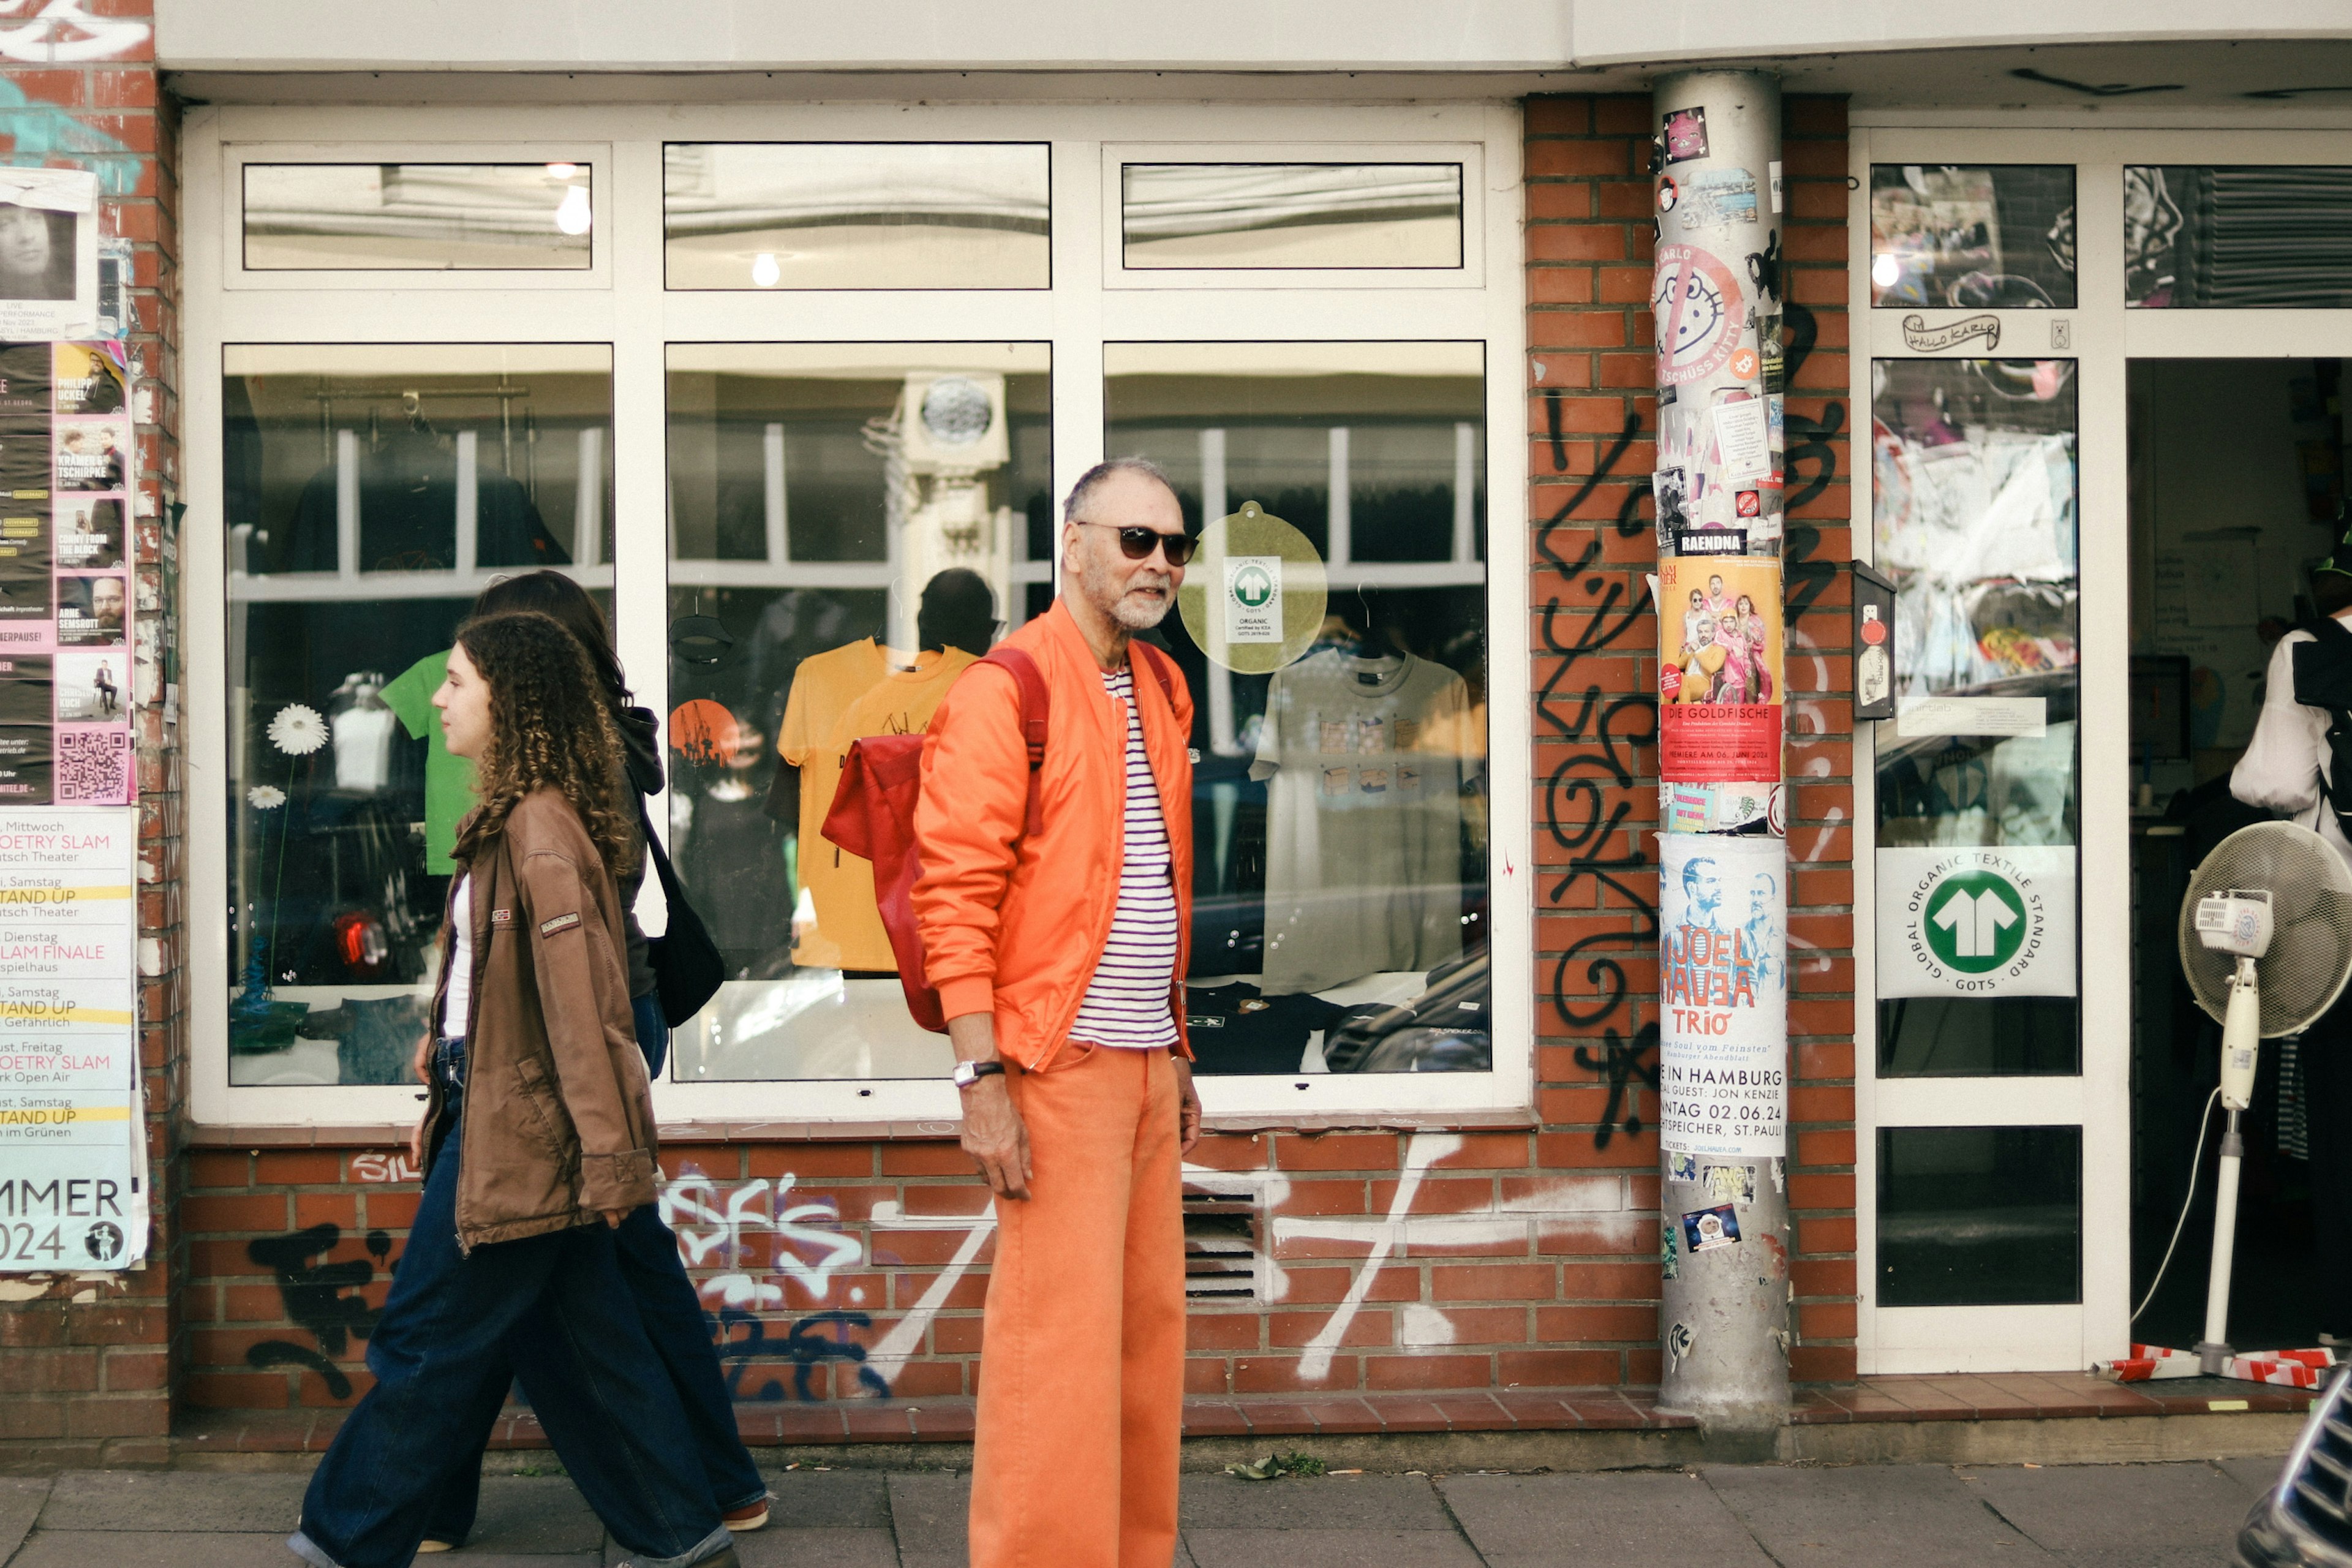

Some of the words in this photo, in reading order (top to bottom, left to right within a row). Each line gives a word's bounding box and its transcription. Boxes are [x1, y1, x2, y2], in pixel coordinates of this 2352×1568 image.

[1659, 249, 1691, 263] KARLO
[1909, 334, 1947, 347] HALLO
[1950, 323, 1996, 342] KARLO
[1661, 358, 1714, 383] TSCHÜSS
[1713, 321, 1740, 362] KITTY
[58, 379, 92, 389] PHILIPP
[58, 390, 86, 401] UCKEL
[58, 467, 106, 478] TSCHIRPKE
[86, 534, 107, 544] FROM
[1681, 535, 1741, 552] RAENDNA
[59, 545, 72, 554] THE
[74, 545, 98, 554] BLOCK
[59, 608, 79, 618] ARNE
[59, 619, 99, 629] SEMSROTT
[59, 698, 80, 707] KUCH
[1669, 708, 1683, 718] DIE
[1688, 707, 1768, 718] GOLDFISCHE
[6, 821, 64, 832] Mittwoch
[61, 835, 109, 849] SLAM
[32, 852, 79, 861] Theater
[1972, 853, 2032, 889] TEXTILE
[10, 877, 61, 889] Samstag
[1909, 854, 1964, 912] ORGANIC
[51, 891, 76, 903] UP
[32, 907, 79, 916] Theater
[4, 932, 58, 944] Dienstag
[2010, 894, 2045, 977] STANDARD
[1, 946, 38, 959] LAM
[43, 946, 105, 959] FINALE
[1907, 920, 1942, 979] GLOBAL
[1956, 979, 1996, 990] GOTS
[8, 987, 59, 999] Samstag
[52, 1001, 76, 1014] UP
[5, 1017, 70, 1027] Gefährlich
[22, 1042, 62, 1054] Freitag
[1674, 1041, 1692, 1050] Soul
[62, 1056, 110, 1069] SLAM
[15, 1073, 49, 1084] Open
[53, 1072, 70, 1082] Air
[1668, 1066, 1682, 1082] IN
[1690, 1068, 1782, 1086] HAMBURG
[1673, 1085, 1708, 1098] GUEST:
[1712, 1088, 1739, 1099] JON
[1744, 1090, 1779, 1100] KENZIE
[20, 1097, 72, 1109] Samstag
[53, 1111, 76, 1125] UP
[1709, 1104, 1781, 1120] 02.06.24
[6, 1127, 21, 1137] im
[25, 1127, 71, 1137] Grünen
[1665, 1140, 1690, 1151] TICKETS:
